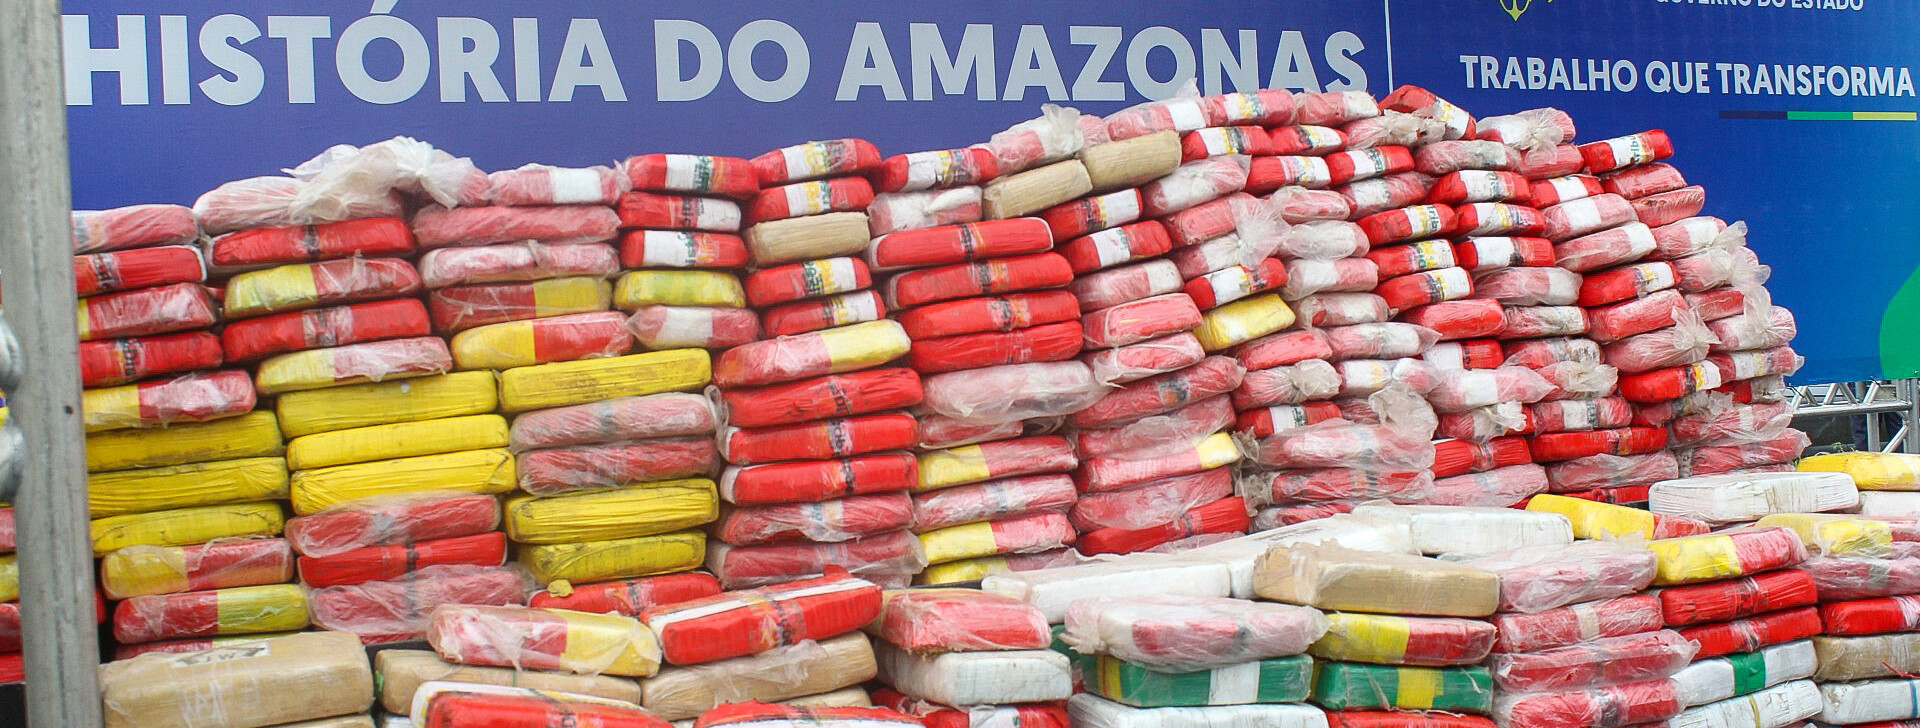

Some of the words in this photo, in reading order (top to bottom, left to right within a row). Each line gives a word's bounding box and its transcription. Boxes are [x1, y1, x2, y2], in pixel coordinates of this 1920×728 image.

[61, 0, 629, 106] HISTÓRIA
[653, 18, 811, 103] DO
[834, 21, 1368, 103] AMAZONAS
[1459, 54, 1638, 93] TRABALHO
[1644, 60, 1711, 94] QUE
[1715, 62, 1917, 98] TRANSFORMA
